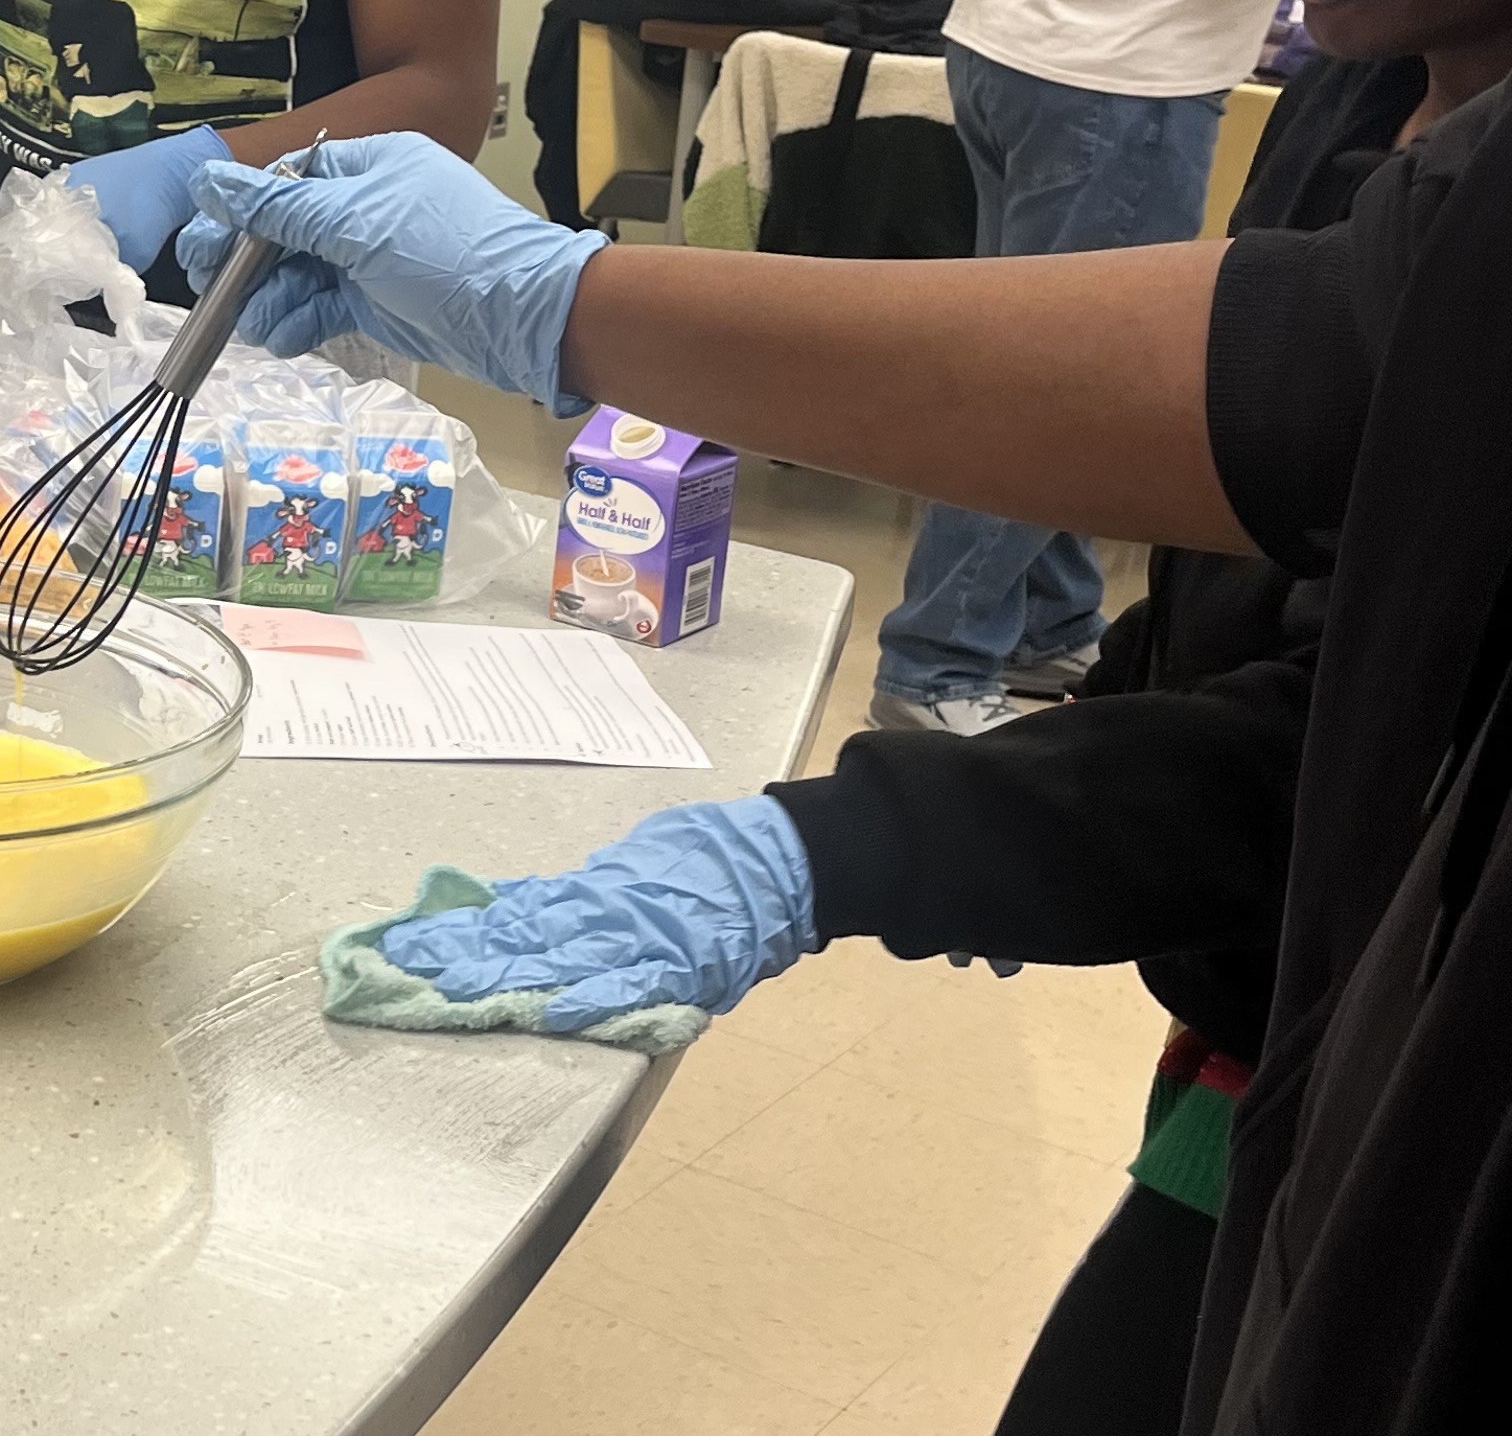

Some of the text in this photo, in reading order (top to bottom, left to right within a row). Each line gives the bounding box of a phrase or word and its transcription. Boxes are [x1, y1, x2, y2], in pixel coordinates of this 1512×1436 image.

[579, 501, 606, 520] Half
[608, 509, 619, 524] &
[621, 512, 652, 531] Half
